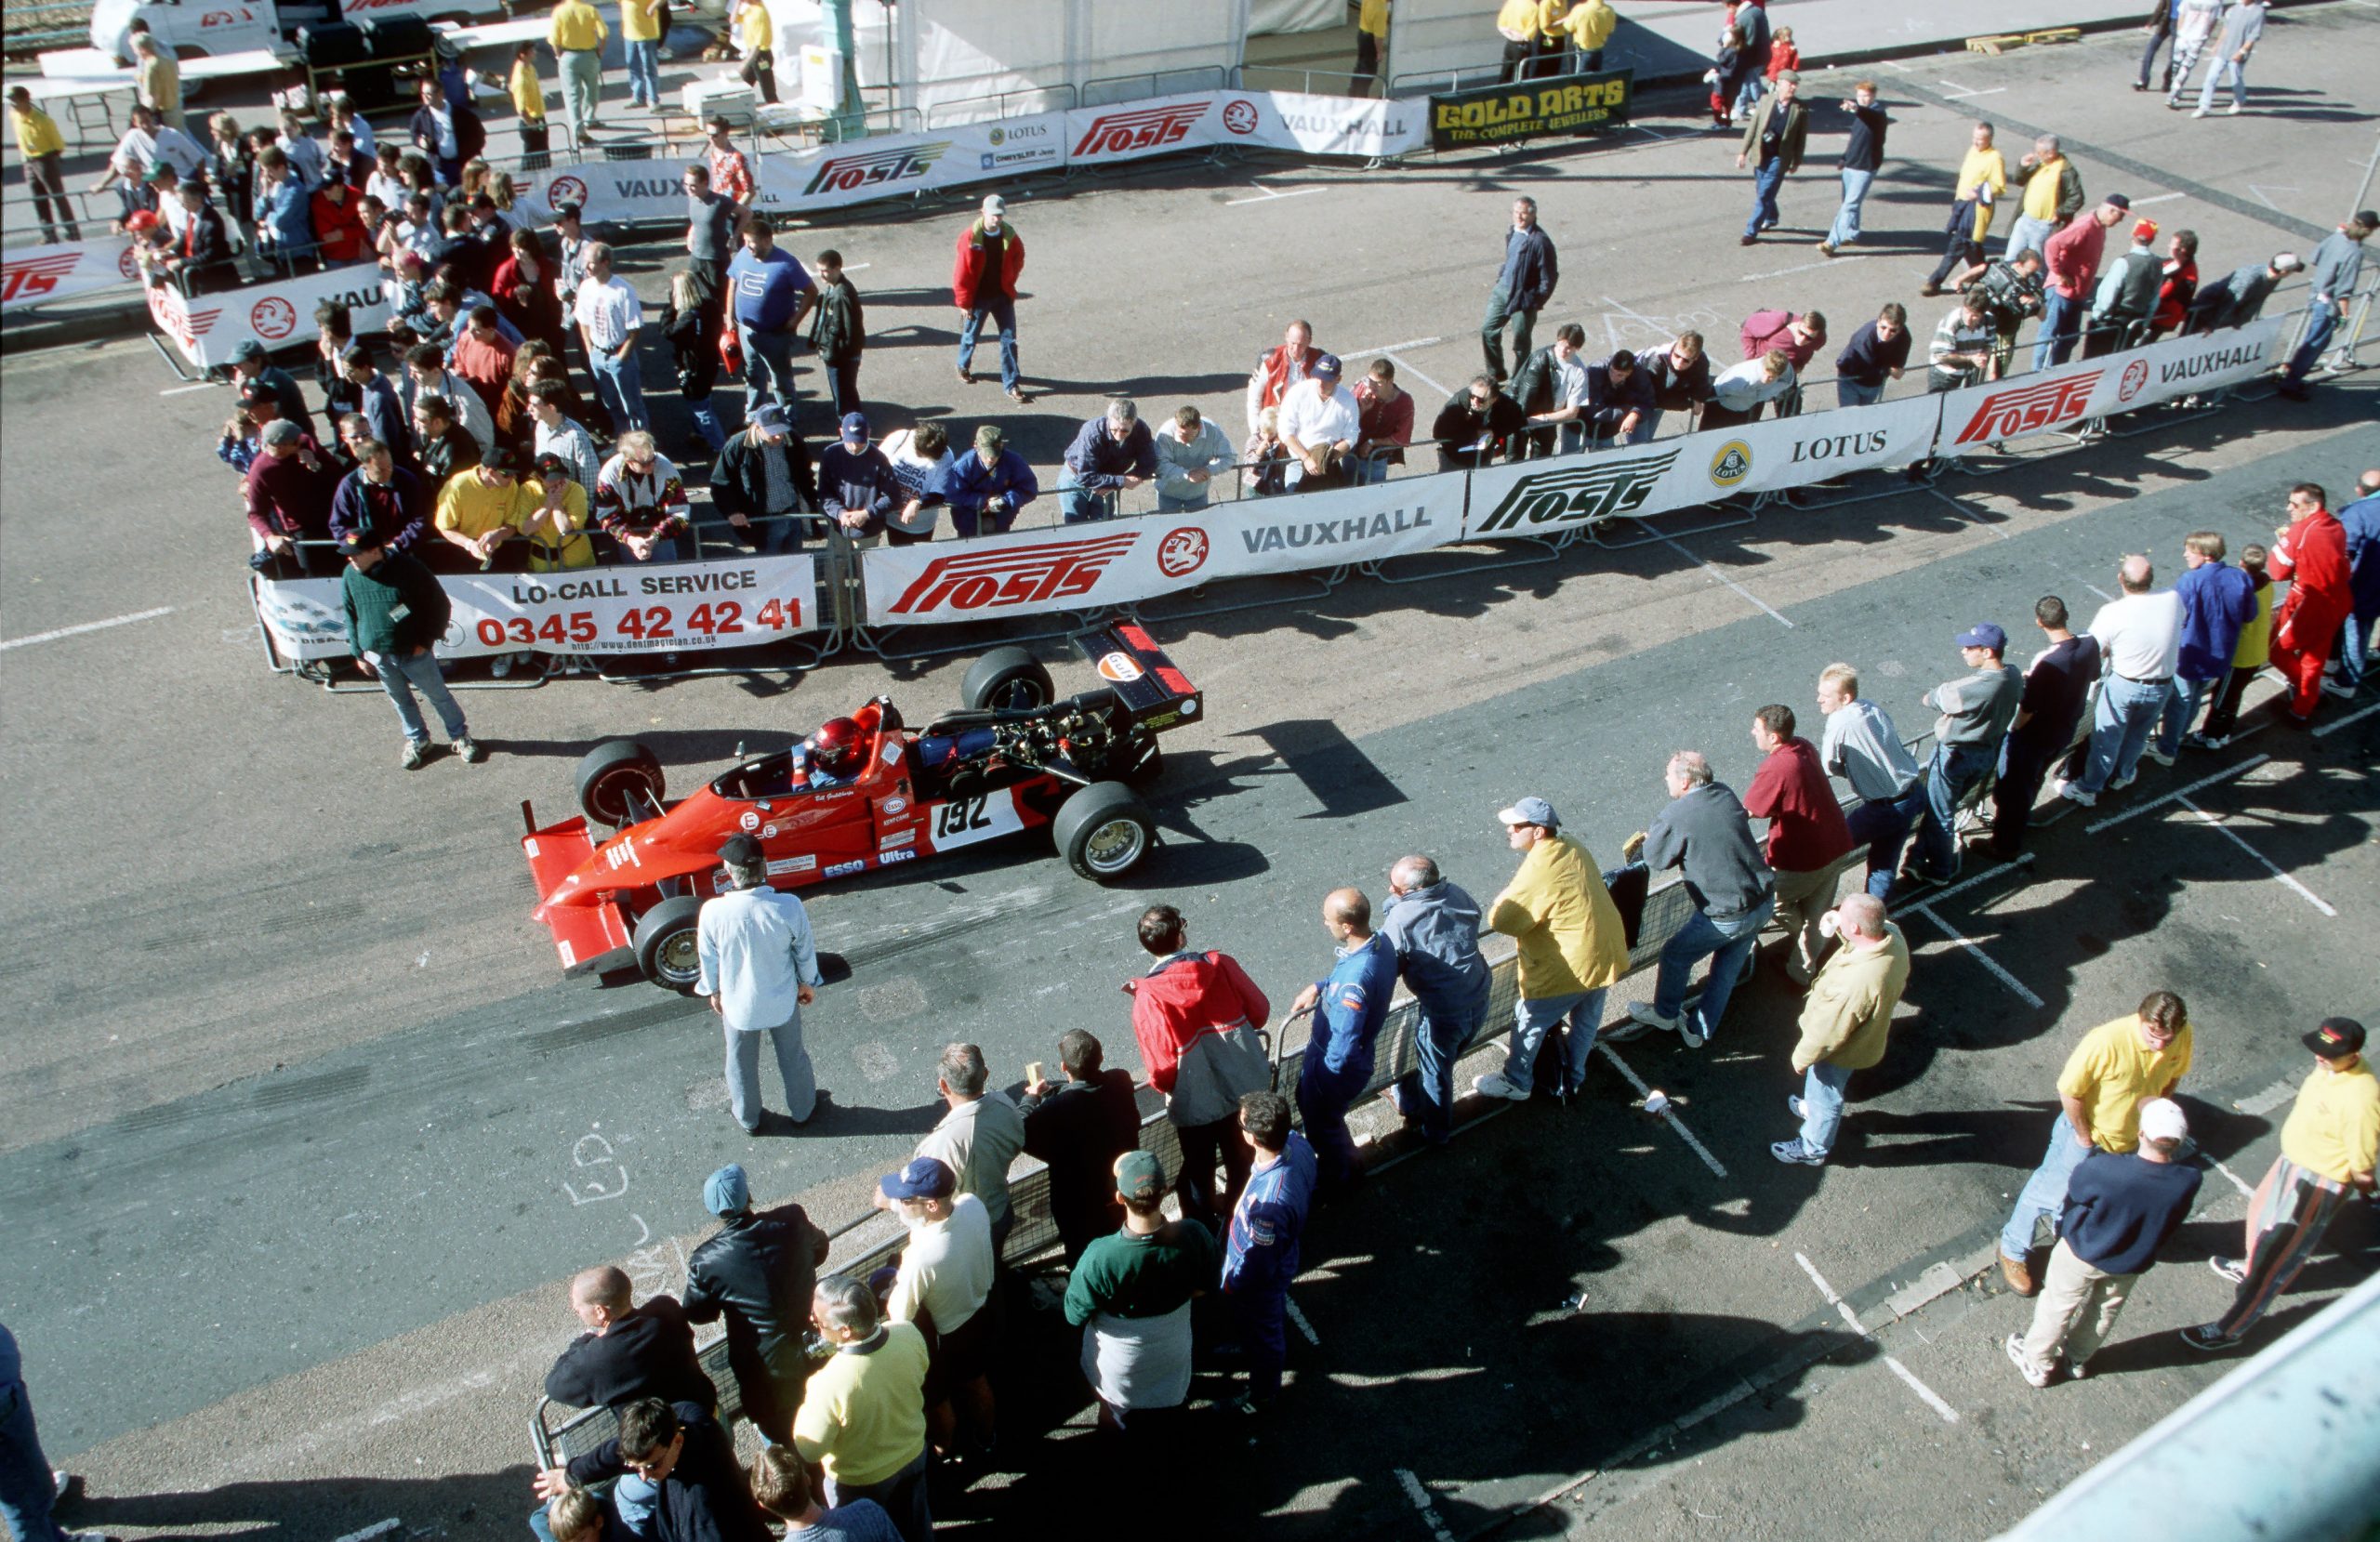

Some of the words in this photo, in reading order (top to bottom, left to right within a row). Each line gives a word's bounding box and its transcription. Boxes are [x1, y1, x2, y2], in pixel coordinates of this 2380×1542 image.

[1436, 95, 1532, 129] GOLD
[1539, 79, 1624, 117] ARTS
[1008, 124, 1047, 140] LOTUS
[1280, 112, 1408, 137] VAUXHALL
[1451, 128, 1476, 140] THE
[1480, 119, 1544, 139] COMPLETE
[1549, 107, 1609, 130] JEWELLERS
[995, 149, 1036, 165] CHRYSLER
[2160, 341, 2263, 383] VAUXHALL
[1791, 429, 1887, 464] LOTUS
[892, 469, 923, 491] OBRA
[895, 458, 927, 481] OBRA
[1714, 464, 1745, 479] LOTUS
[1241, 506, 1433, 555] VAUXHALL
[513, 578, 628, 605] LO-CALL
[641, 570, 757, 595] SERVICE
[476, 611, 598, 647] 0345
[616, 606, 674, 640] 42
[687, 600, 743, 636] 42
[757, 598, 802, 631] 41
[1109, 654, 1136, 679] Gulf
[887, 801, 902, 811] Esso
[937, 794, 992, 839] 192
[744, 814, 755, 829] E
[766, 826, 774, 837] E
[879, 849, 916, 864] Ultra
